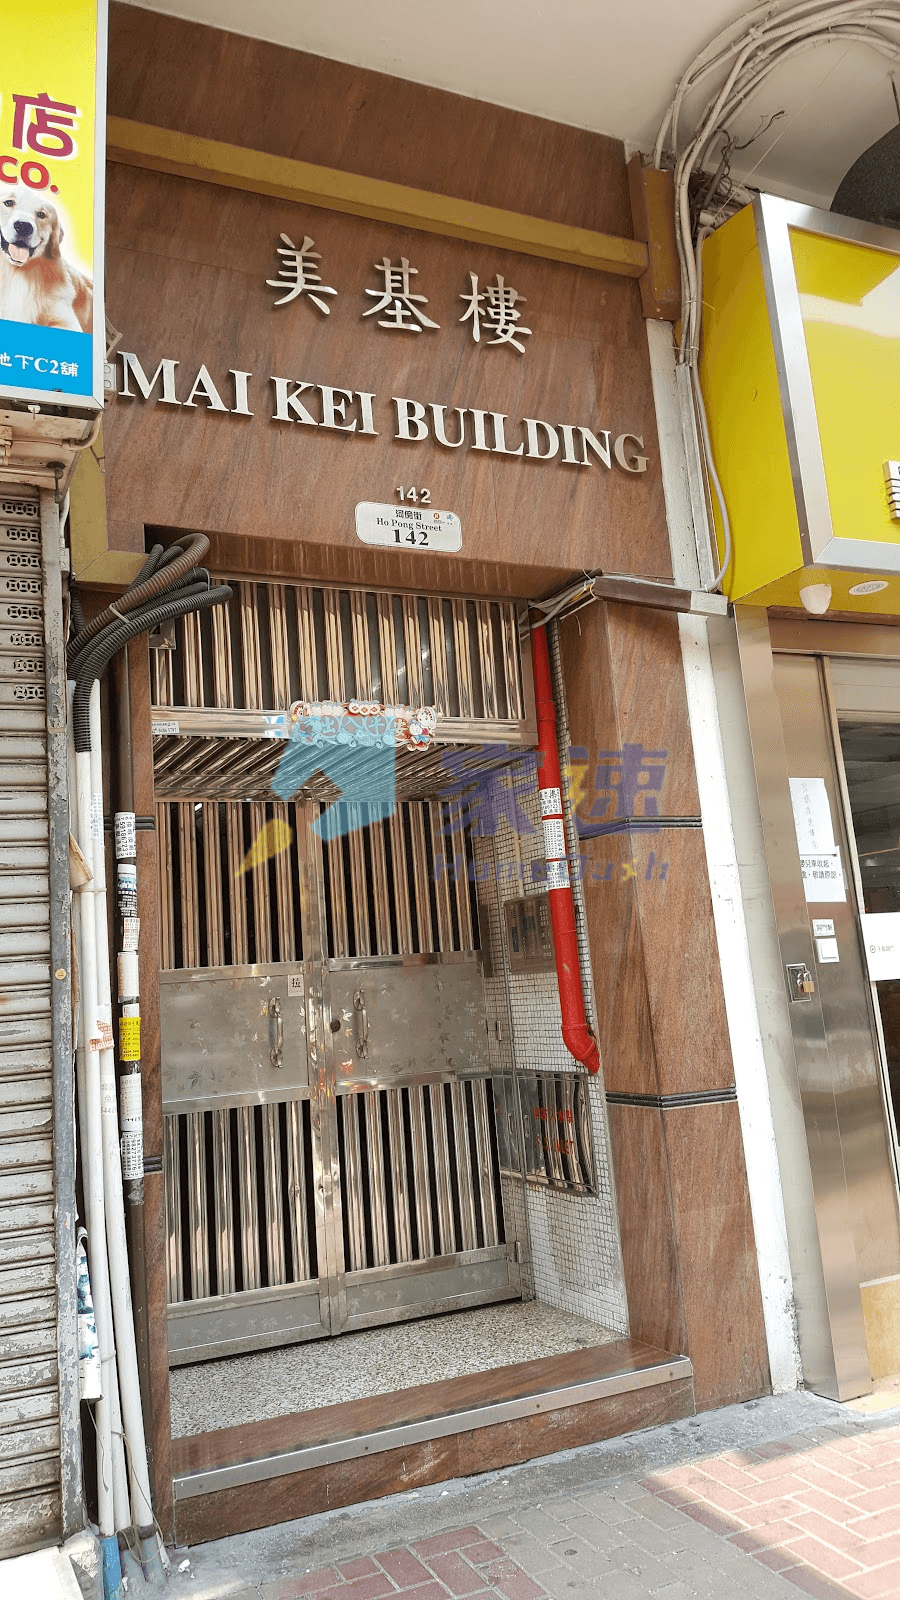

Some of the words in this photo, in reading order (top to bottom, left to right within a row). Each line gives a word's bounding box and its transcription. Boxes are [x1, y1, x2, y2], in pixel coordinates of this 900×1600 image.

[12, 92, 77, 158] 店
[265, 232, 533, 354] 美基樓
[117, 350, 254, 417] MAI
[270, 376, 380, 436] KEI
[392, 396, 650, 473] BUILDING
[396, 485, 432, 504] 142
[376, 517, 389, 526] Ho
[391, 519, 414, 530] Pong
[415, 521, 442, 532] Street
[391, 529, 429, 546] 142
